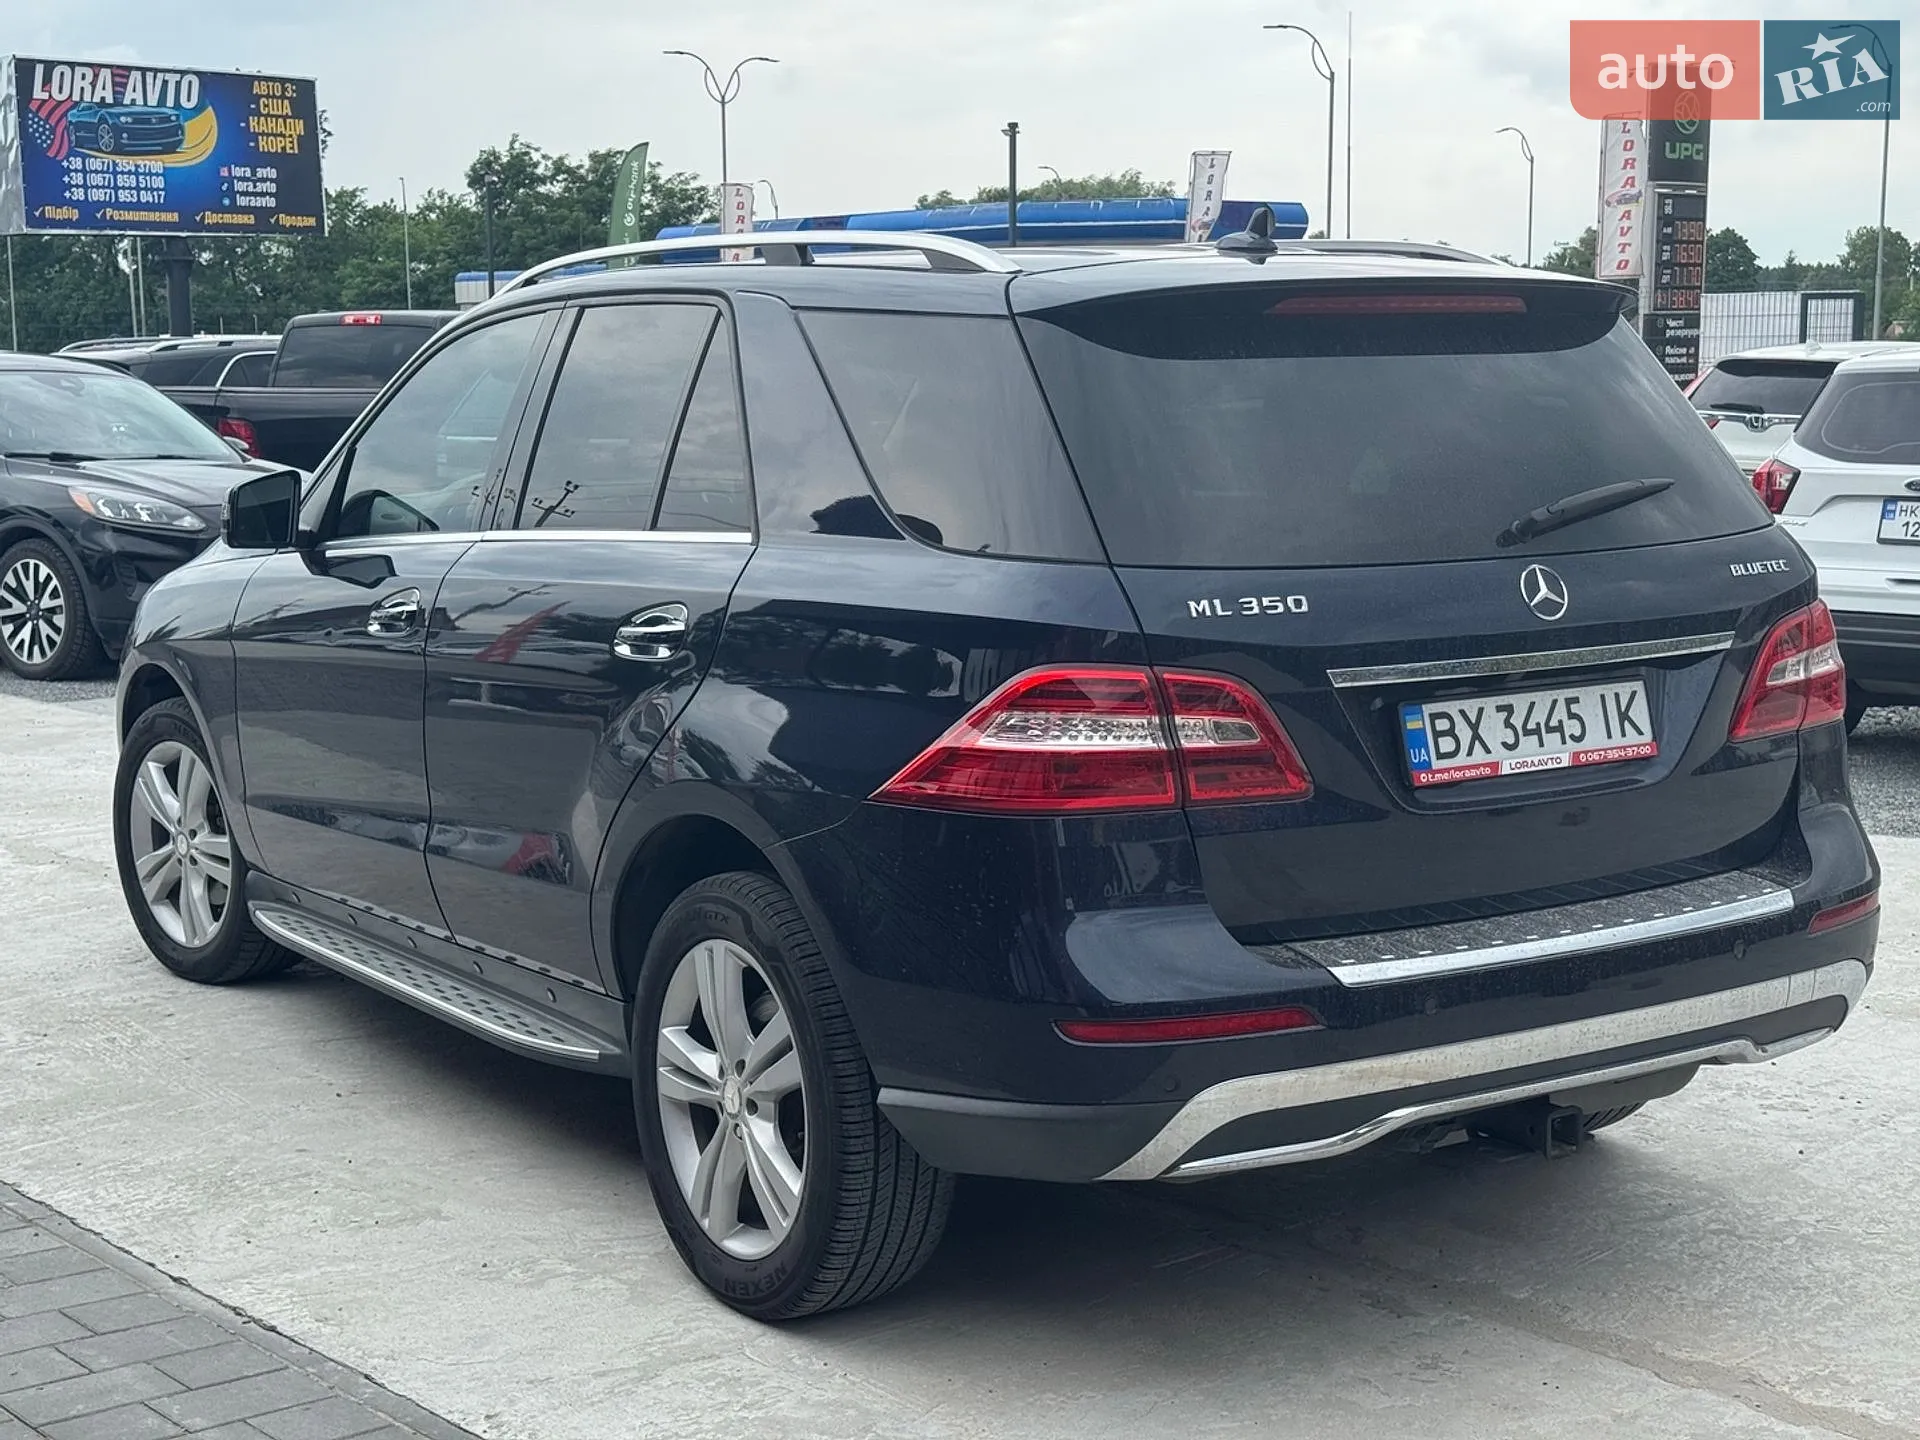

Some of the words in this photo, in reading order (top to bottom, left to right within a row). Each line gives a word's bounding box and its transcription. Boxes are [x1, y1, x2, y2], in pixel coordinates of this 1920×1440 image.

[32, 63, 114, 104] LORA
[122, 70, 200, 109] AVTO
[253, 80, 282, 96] АВТО
[260, 97, 292, 116] США
[249, 116, 304, 137] КАНАДИ
[1620, 121, 1637, 189] LORA
[1665, 141, 1704, 160] UPG
[62, 157, 83, 169] +38
[85, 158, 112, 172] (067)
[115, 160, 135, 172] 354
[137, 161, 163, 174] 3700
[231, 164, 278, 180] lora_avto
[62, 172, 84, 185] +38
[86, 173, 114, 187] (067)
[117, 174, 137, 188] 859
[139, 175, 165, 189] 5100
[234, 179, 277, 193] lora.avto
[64, 187, 85, 201] +38
[87, 188, 115, 203] (097)
[118, 189, 138, 203] 953
[140, 190, 165, 204] 0417
[236, 194, 276, 208] loraavto
[45, 205, 79, 222] Підбір
[105, 207, 179, 223] Розмитнення
[204, 211, 255, 225] Доставка
[279, 213, 317, 228] Продаж
[1616, 209, 1633, 271] AVTO
[1729, 559, 1790, 577] BLUETEC
[1187, 599, 1233, 618] ML
[1238, 595, 1309, 615] 350
[1428, 706, 1492, 761] BX
[1496, 696, 1587, 751] 3445
[1600, 690, 1645, 740] IK
[1410, 748, 1429, 763] UA
[1509, 756, 1562, 771] LORAAVTO
